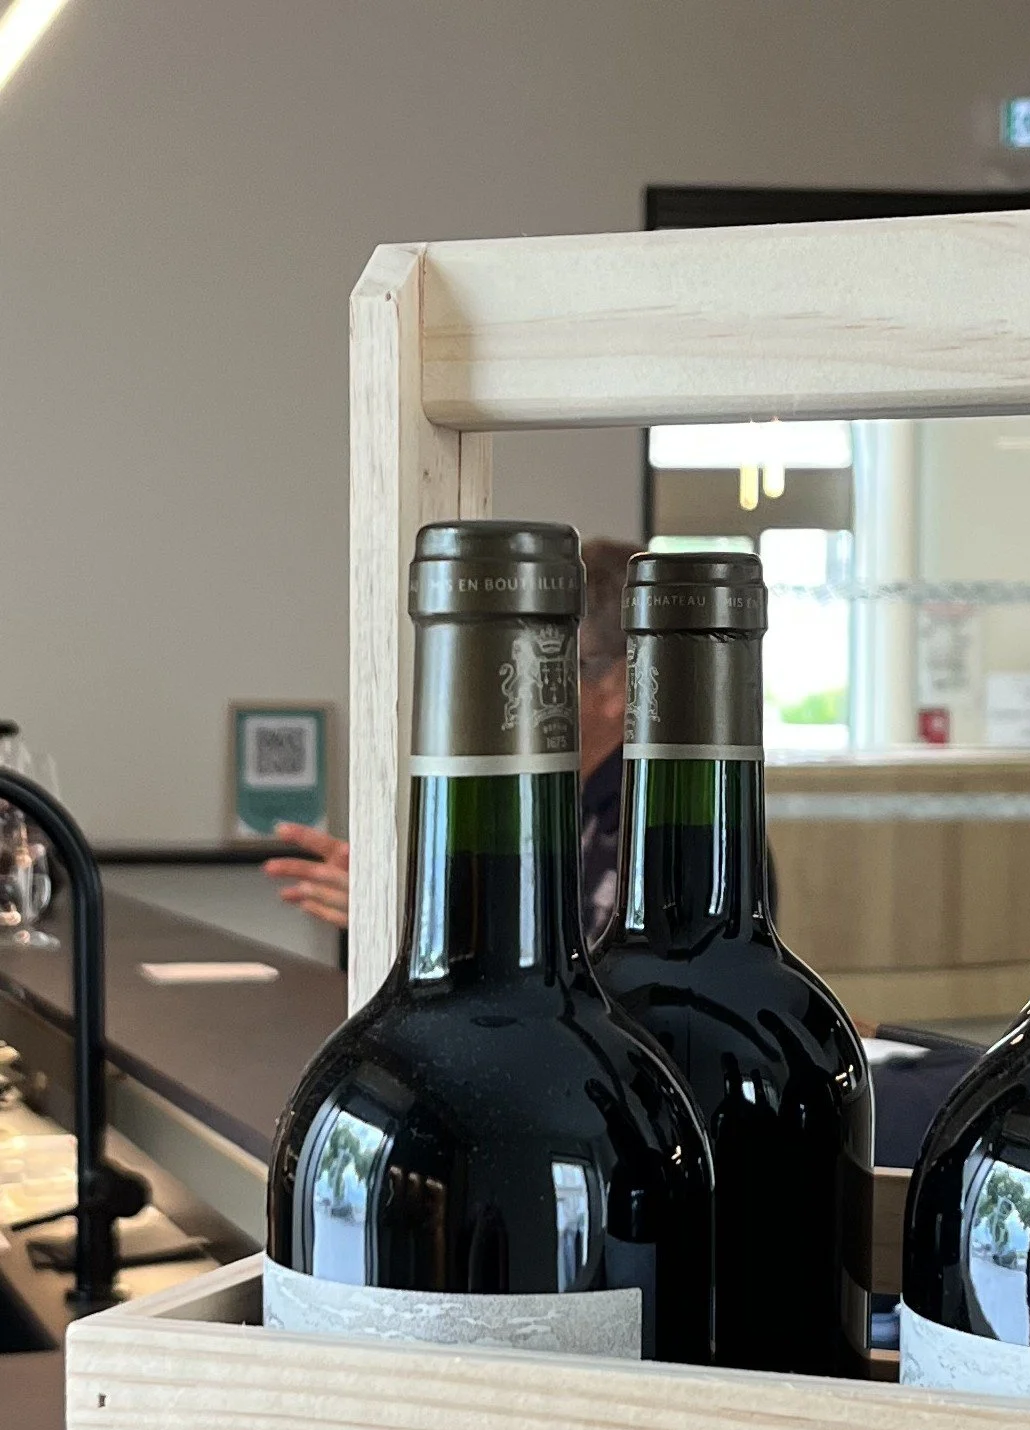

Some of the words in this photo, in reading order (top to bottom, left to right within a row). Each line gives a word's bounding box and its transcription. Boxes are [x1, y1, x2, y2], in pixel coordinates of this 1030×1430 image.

[458, 577, 478, 592] EN
[484, 576, 565, 592] BOUTILLE
[647, 594, 706, 608] CHATEAU
